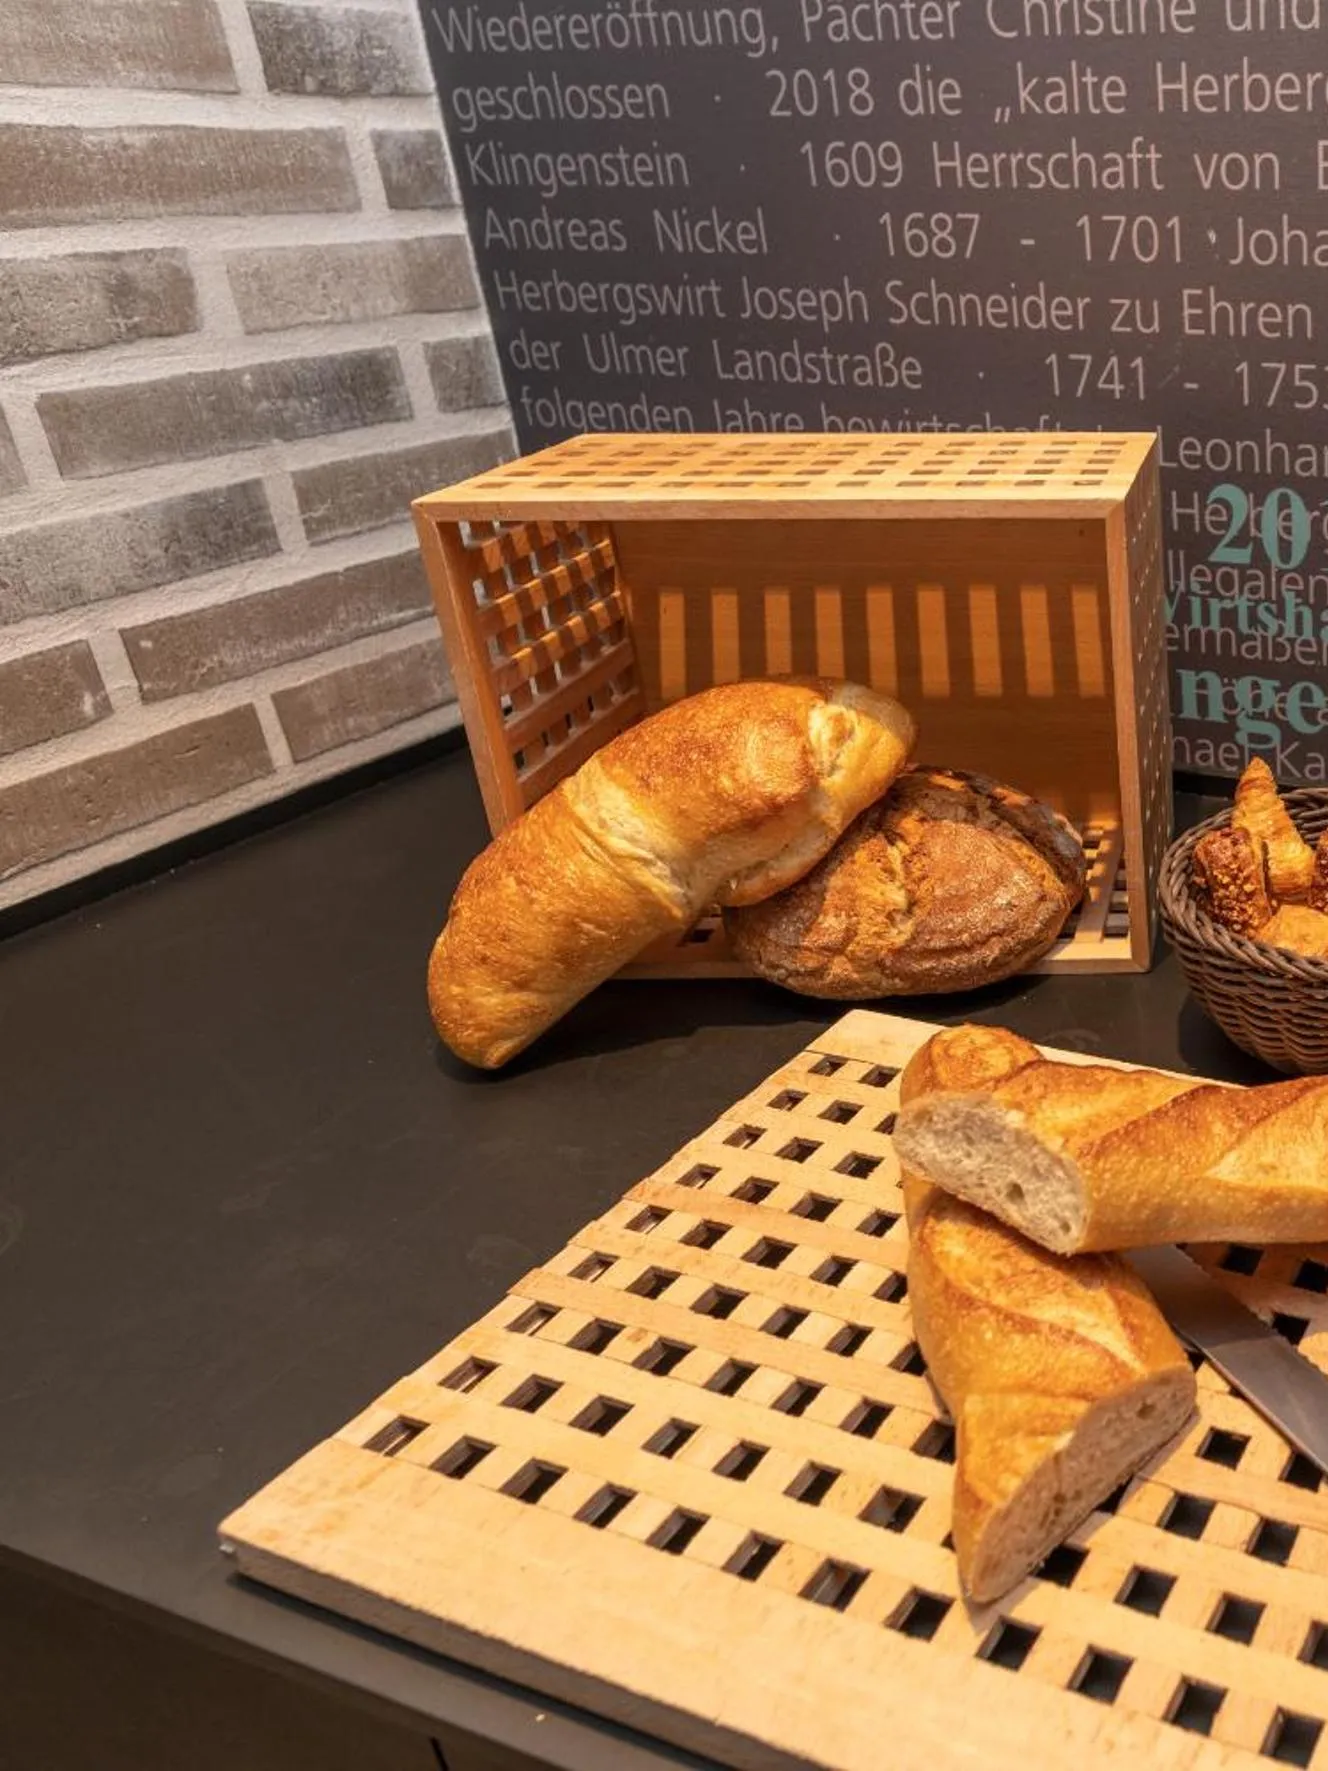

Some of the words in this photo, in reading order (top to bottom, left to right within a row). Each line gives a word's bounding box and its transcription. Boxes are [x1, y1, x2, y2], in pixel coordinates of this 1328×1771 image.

[432, 0, 778, 57] Wiedereröffnung,
[452, 72, 670, 132] geschlossen
[766, 68, 874, 117] 2018
[899, 63, 962, 116] die
[464, 141, 690, 198] Klingenstein
[800, 140, 902, 188] 1609
[932, 137, 1164, 190] Herrschaft
[1194, 153, 1281, 190] von
[483, 206, 628, 252] Andreas
[652, 206, 768, 255] Nickel
[879, 212, 980, 260] 1687
[1075, 215, 1182, 263] 1701
[493, 268, 727, 327] Herbergswirt
[740, 273, 869, 333] Joseph
[885, 280, 1092, 331] Schneider
[1110, 298, 1160, 334] zu
[1181, 289, 1313, 340] Ehren
[510, 328, 562, 371] der
[582, 331, 689, 378] Ulmer
[712, 338, 924, 390] Landstraße
[1043, 354, 1147, 401] 1741
[520, 385, 695, 434] folgenden
